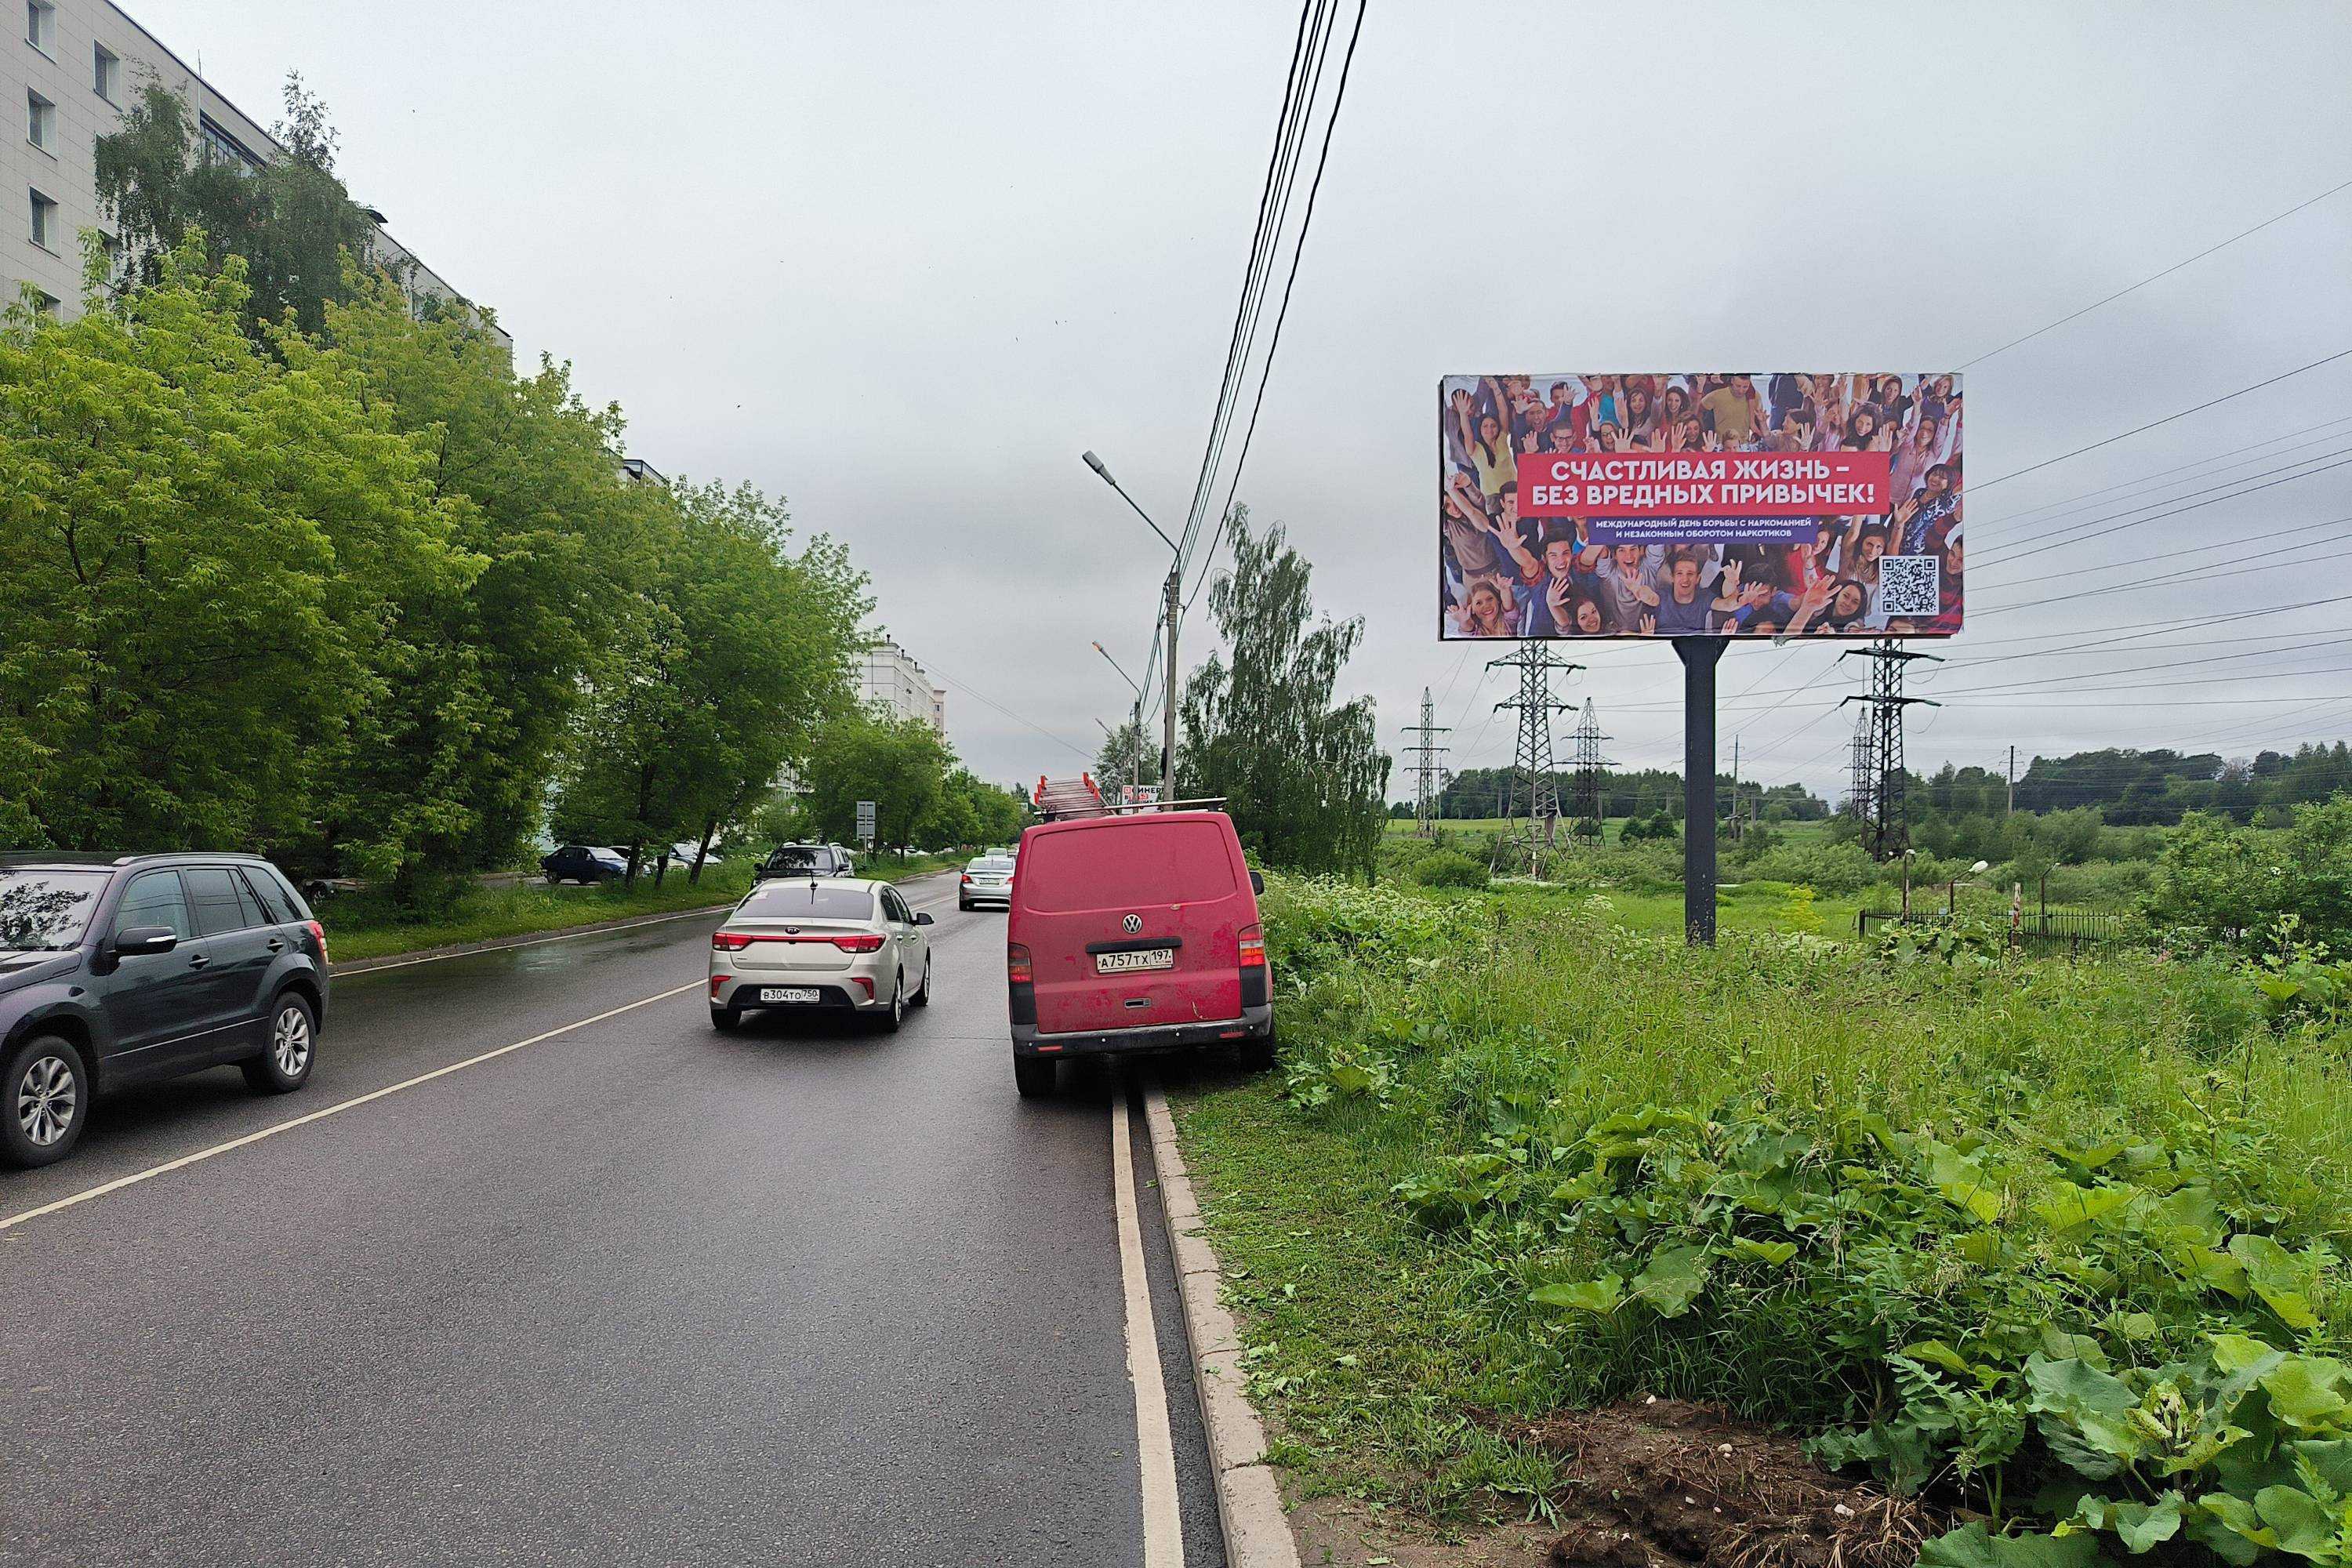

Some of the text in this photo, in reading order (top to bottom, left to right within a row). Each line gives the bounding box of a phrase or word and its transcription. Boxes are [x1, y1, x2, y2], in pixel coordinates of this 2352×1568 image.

[1551, 460, 1726, 481] СЧАСТЛИВАЯ
[1733, 459, 1830, 480] ЖИЗНЬ
[1533, 483, 1875, 508] БЕЗ ВРЕДНЫХ ПРИВЫЧЕК!
[1595, 518, 1677, 528] МЕЖДУНАРОДНЫЙ
[1748, 517, 1812, 527] НАРКОМАНИЕЙ
[1686, 529, 1733, 538] ОБОРОТОМ
[1101, 949, 1169, 968] А757ТХ 197
[764, 989, 817, 1000] В304ТО 750
